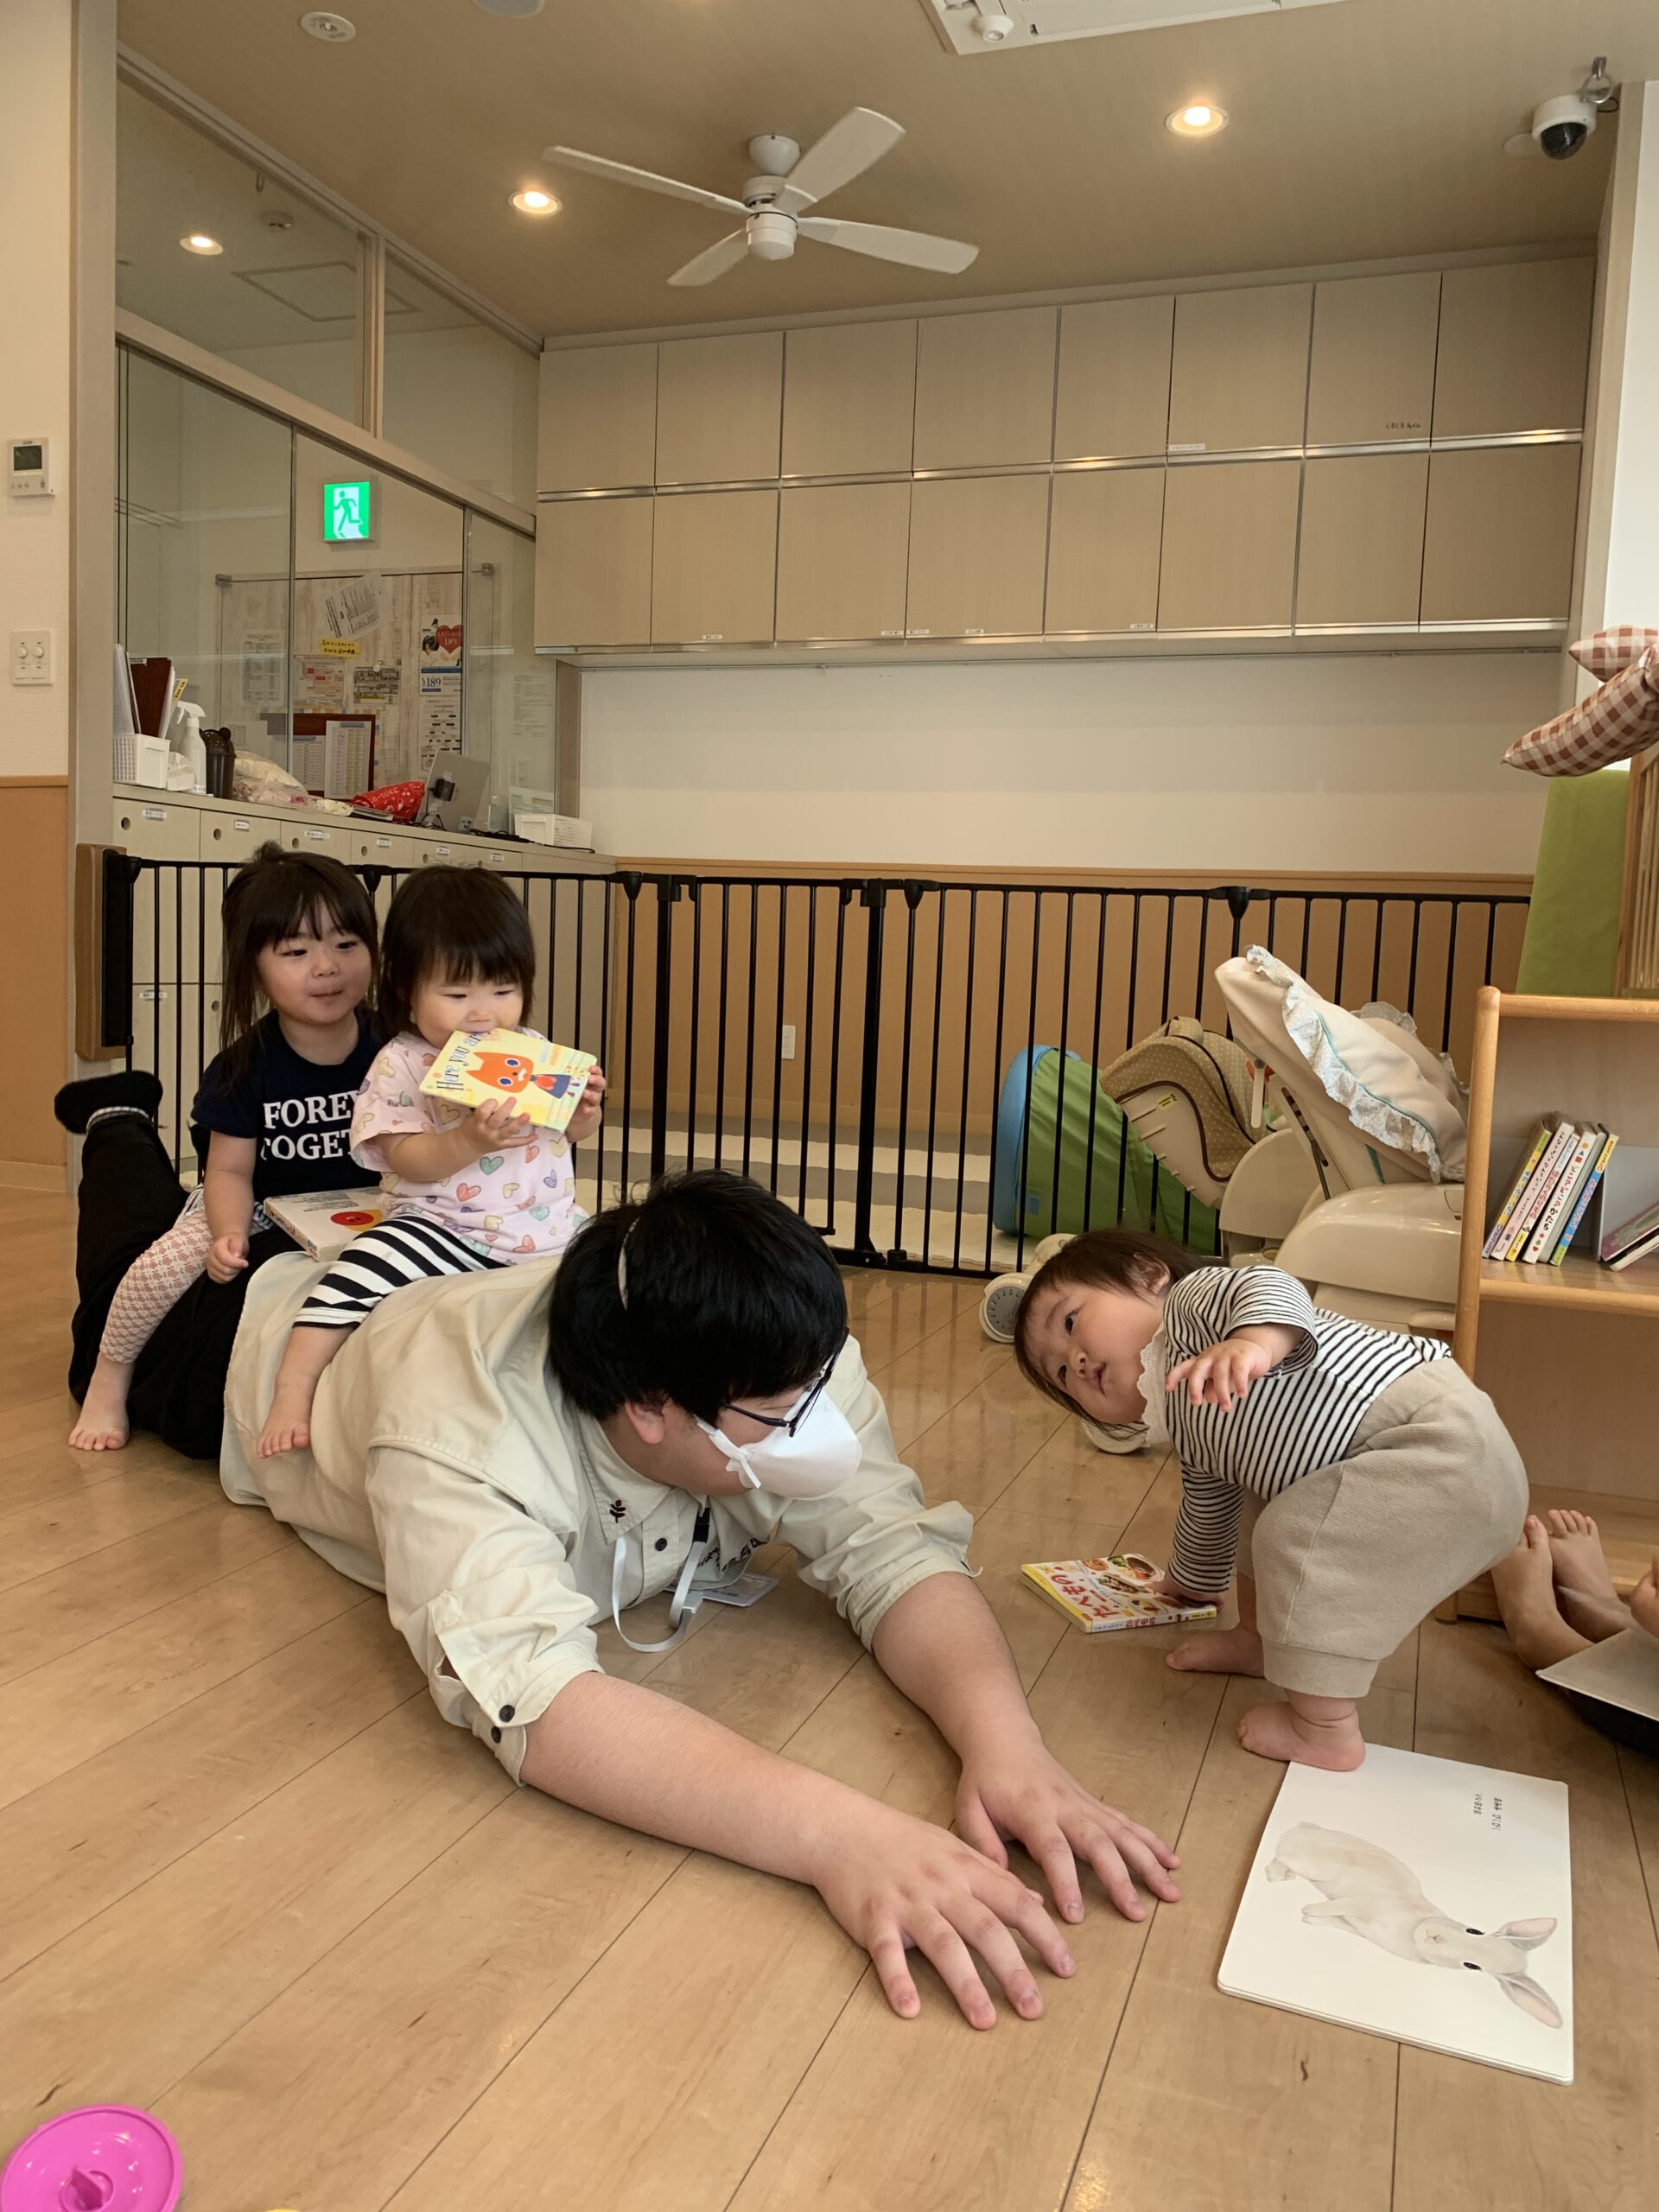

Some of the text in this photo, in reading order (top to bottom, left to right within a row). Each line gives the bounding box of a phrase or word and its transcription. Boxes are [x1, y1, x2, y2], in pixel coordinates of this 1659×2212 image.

[427, 677, 442, 688] 189
[449, 1046, 469, 1066] you
[436, 1065, 464, 1090] Here
[1051, 1574, 1121, 1620] たべもの
